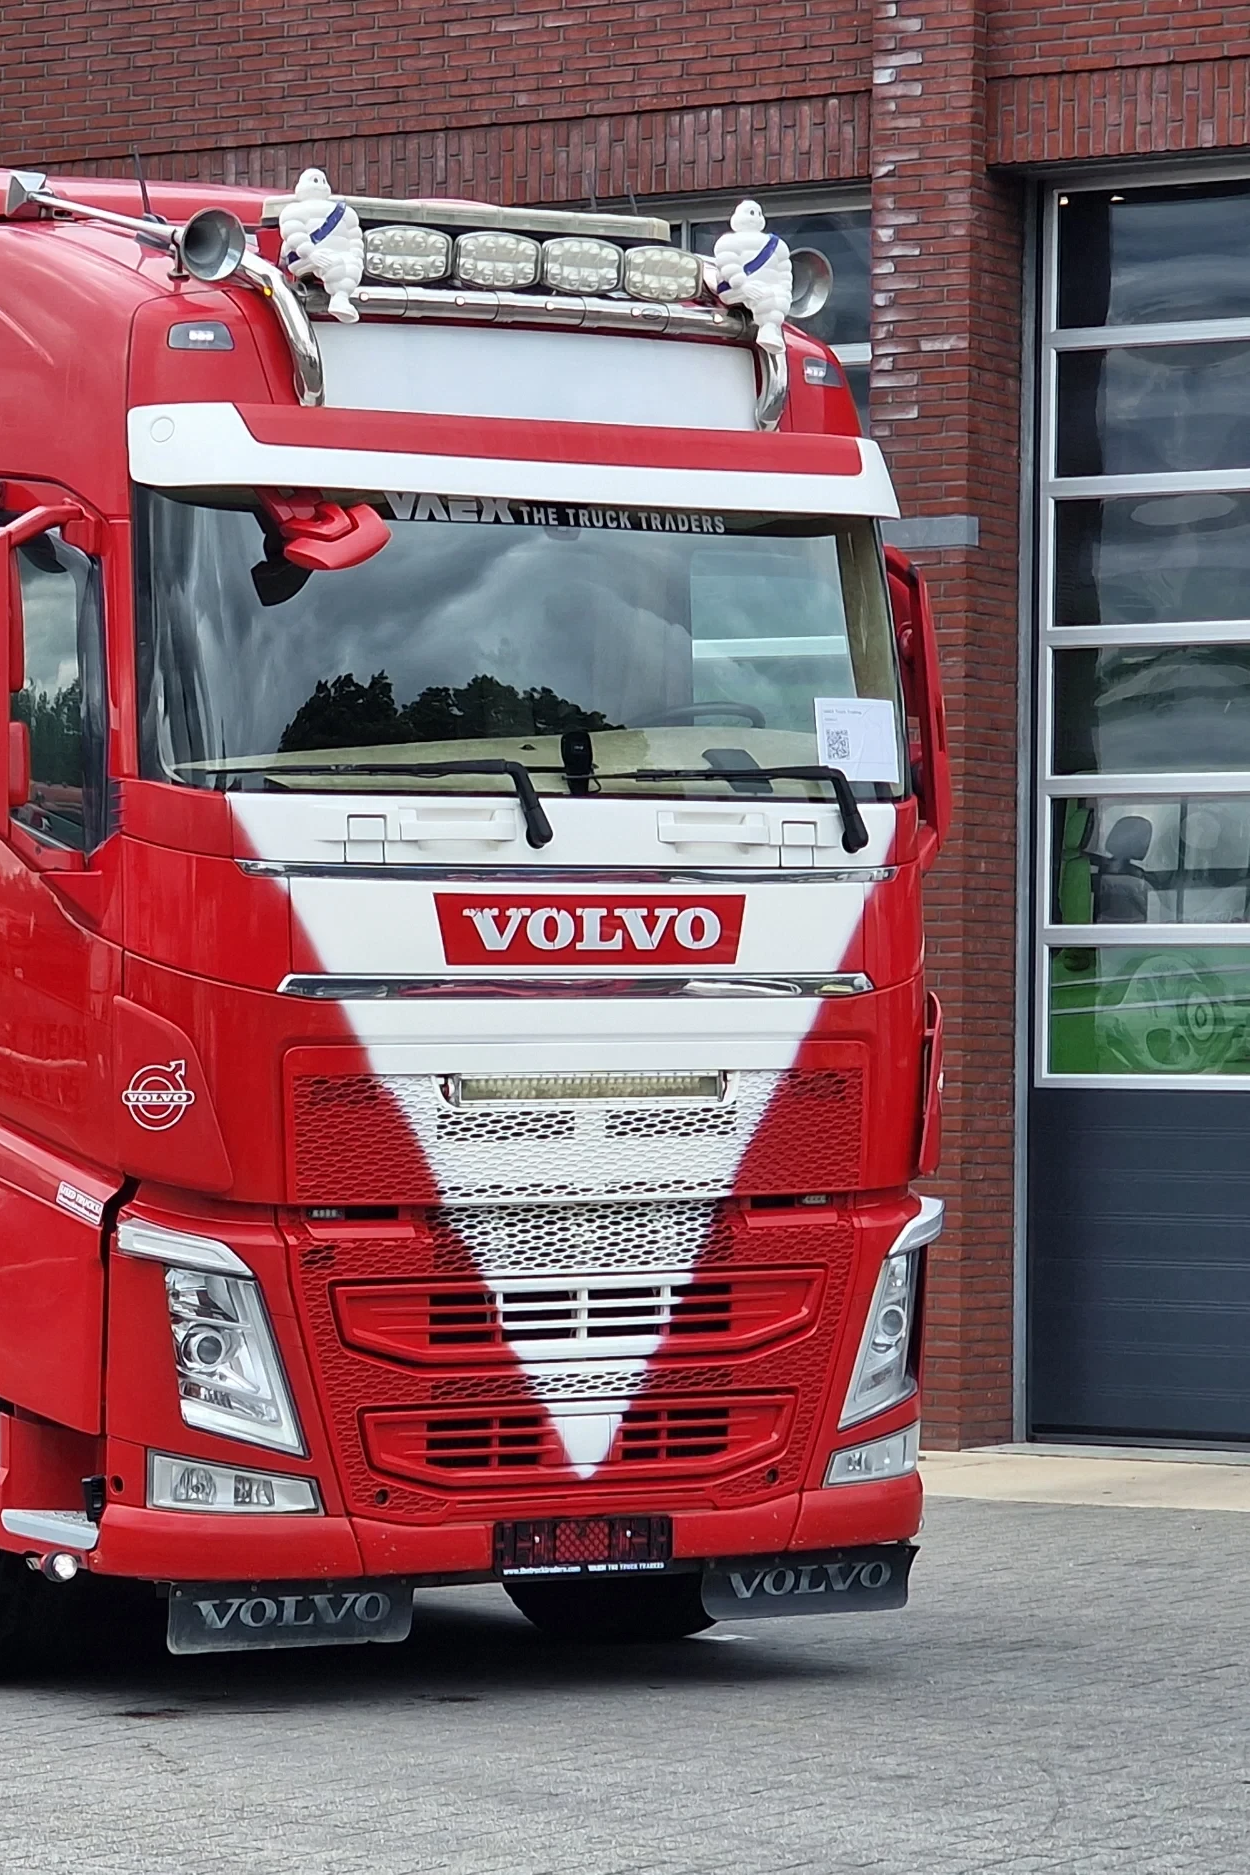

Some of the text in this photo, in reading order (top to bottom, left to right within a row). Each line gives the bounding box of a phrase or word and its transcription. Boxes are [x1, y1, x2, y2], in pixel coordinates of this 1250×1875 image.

[519, 505, 558, 526] THE
[565, 507, 631, 530] TRUCK
[637, 511, 726, 534] TRADERS
[462, 906, 722, 951] VOLVO
[127, 1093, 188, 1103] VOLVO
[728, 1560, 892, 1599] VOLVO
[192, 1591, 391, 1629] VOLVO
